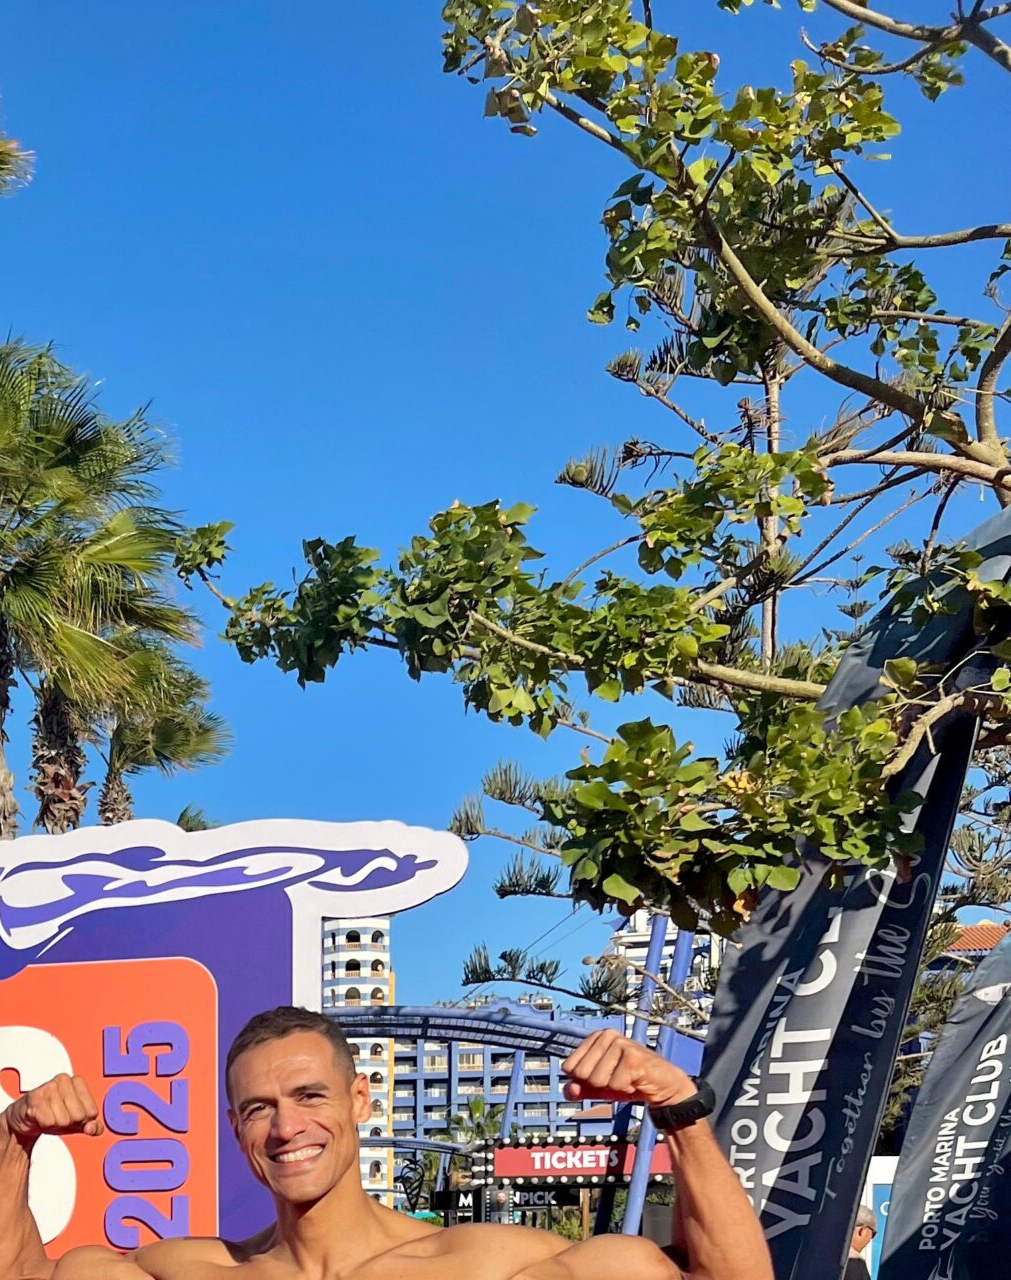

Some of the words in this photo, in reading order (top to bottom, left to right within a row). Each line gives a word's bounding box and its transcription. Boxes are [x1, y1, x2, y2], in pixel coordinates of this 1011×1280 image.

[853, 923, 911, 987] the
[851, 990, 896, 1040] by
[962, 1033, 1008, 1127] CLUB
[102, 1019, 191, 1251] 2025
[531, 1149, 619, 1170] TICKETS
[761, 1017, 832, 1241] YACHT
[818, 1052, 872, 1214] Together
[929, 1107, 961, 1184] MARINA
[919, 1186, 946, 1251] PORTO
[939, 1134, 989, 1251] YACHT
